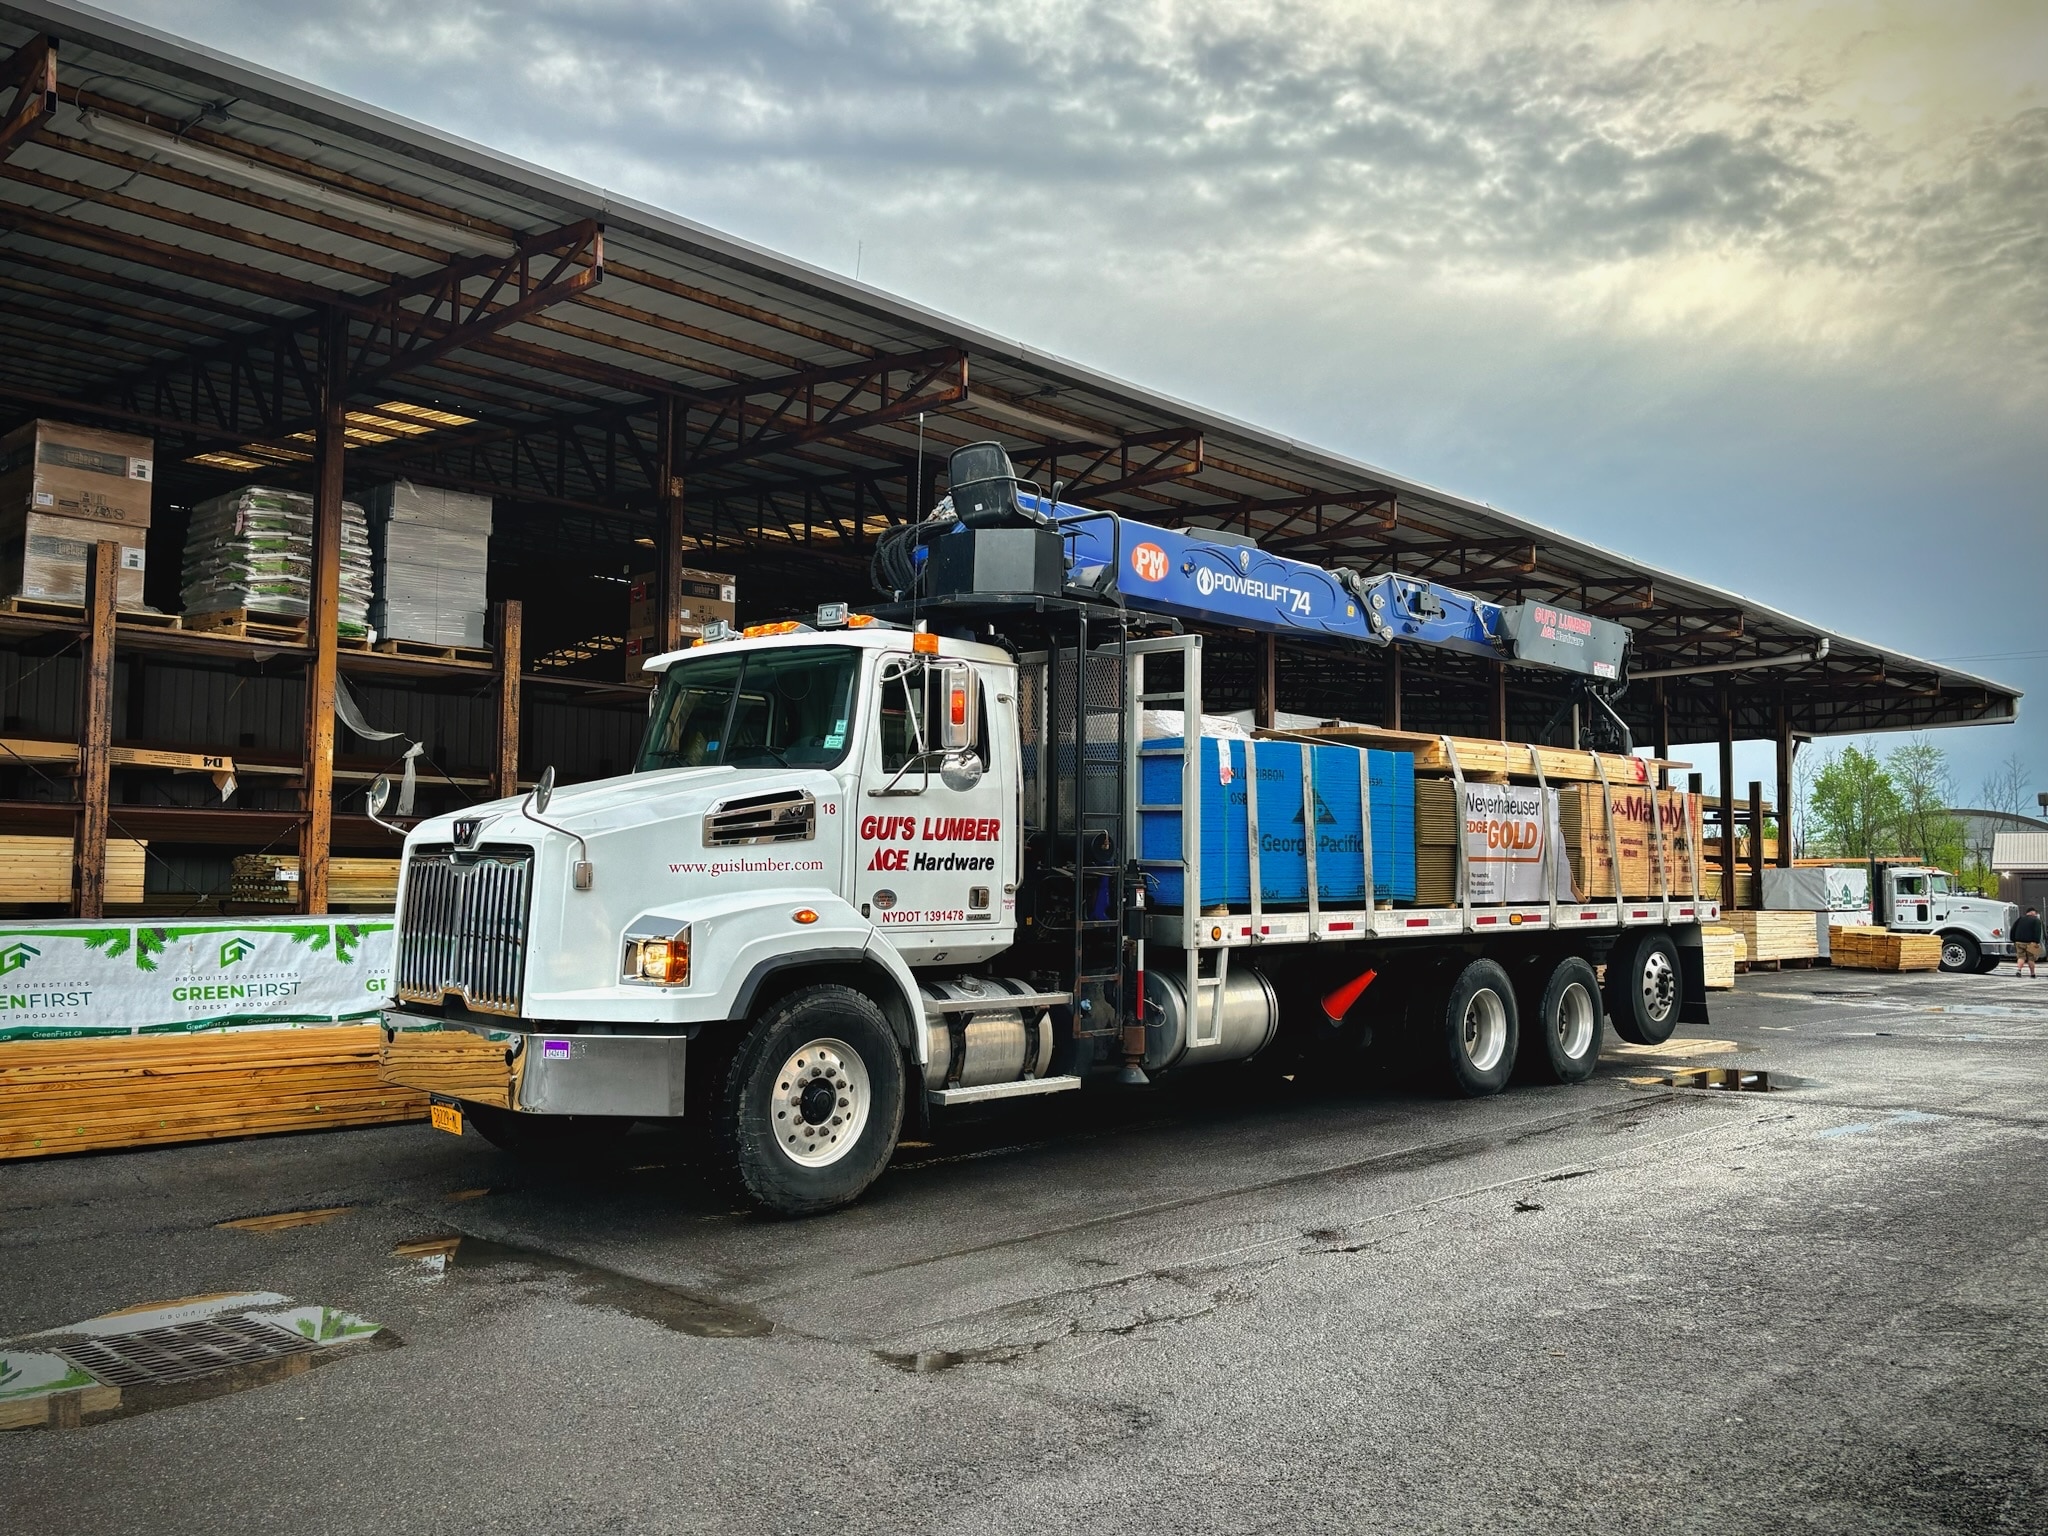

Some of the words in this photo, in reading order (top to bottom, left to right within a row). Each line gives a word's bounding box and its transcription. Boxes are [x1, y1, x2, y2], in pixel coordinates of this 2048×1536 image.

[1136, 547, 1164, 580] PM
[1214, 573, 1289, 603] POWERLIFT
[1289, 590, 1311, 615] 74
[1534, 607, 1557, 627] GUI'S
[1558, 613, 1592, 636] LUMBER
[822, 803, 836, 815] 18
[1626, 795, 1683, 832] Maply
[860, 816, 916, 841] GUI'S
[922, 817, 1001, 841] LUMBER
[1488, 820, 1538, 849] GOLD
[1261, 833, 1364, 857] Georg-Pacific
[668, 857, 824, 877] www.guislumber.com
[866, 846, 909, 871] ACE
[913, 852, 995, 871] Hardware
[882, 911, 921, 923] NYDOT
[924, 910, 964, 922] 1391478
[16, 981, 91, 989] FORESTIERS
[175, 974, 229, 982] PRODUITS
[235, 972, 299, 980] FORESTIERS
[0, 991, 93, 1010] ENFIRST
[172, 981, 302, 1002] GREENFIRST
[15, 1011, 79, 1020] PRODUCTS
[188, 1003, 228, 1011] FOREST
[235, 1000, 288, 1008] PRODUCTS
[32, 1030, 82, 1039] GreenFirst.ca
